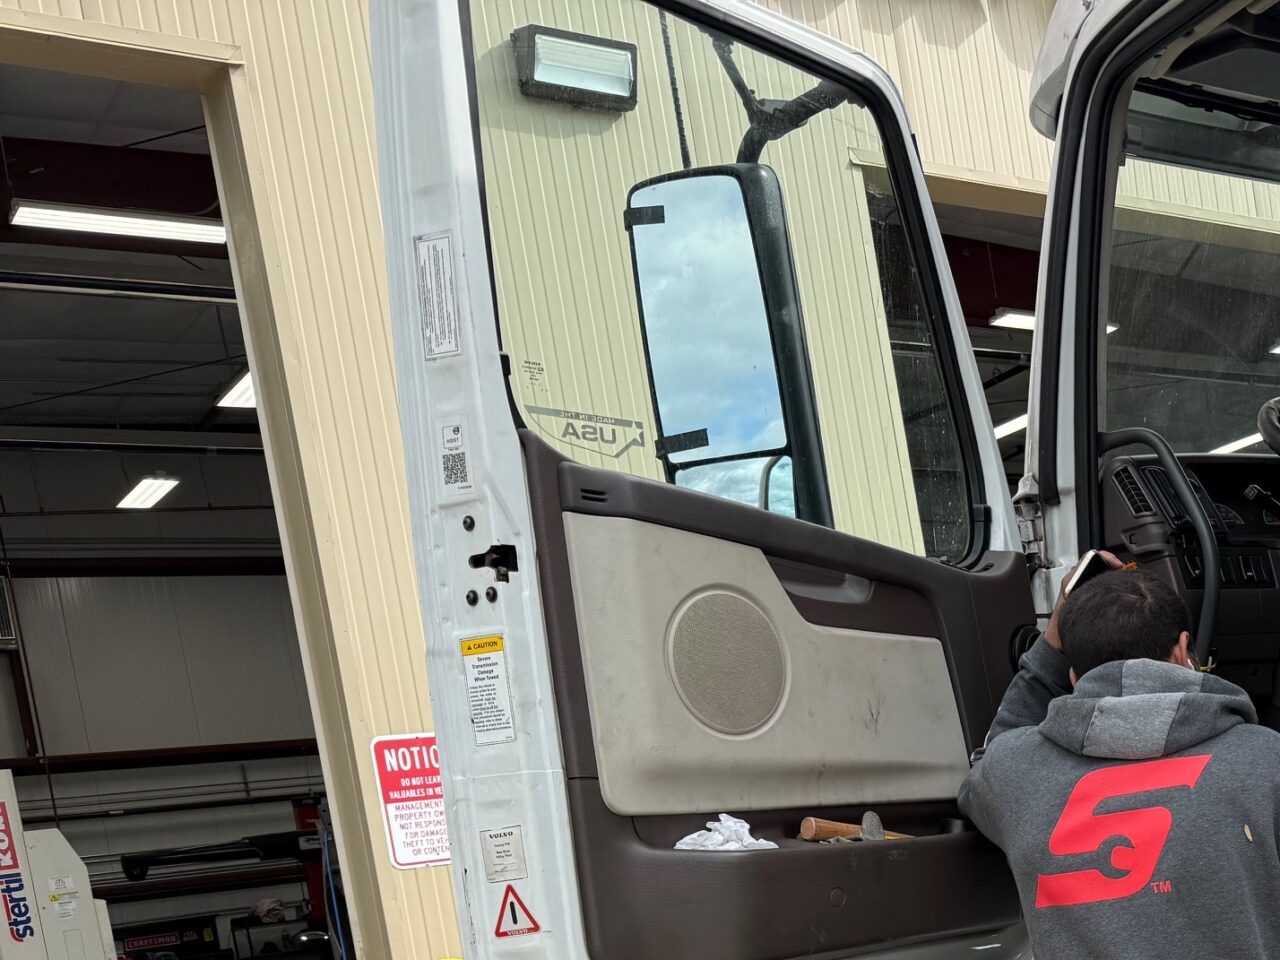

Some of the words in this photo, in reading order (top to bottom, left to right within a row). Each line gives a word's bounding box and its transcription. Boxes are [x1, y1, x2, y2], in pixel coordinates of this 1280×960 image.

[473, 640, 498, 650] CAUTION
[472, 661, 498, 670] Transmission
[400, 778, 410, 787] DO
[412, 776, 424, 786] NOT
[388, 788, 426, 799] VALUABLES
[426, 787, 434, 796] IN
[394, 811, 432, 822] PROPERTY
[399, 822, 413, 830] NOT
[488, 831, 514, 839] VOLVO
[403, 839, 425, 848] THEFT
[426, 838, 434, 846] TO
[412, 848, 422, 856] OR
[1151, 880, 1172, 894] TM
[0, 872, 34, 942] stertil
[507, 928, 529, 936] VOLVO
[127, 934, 177, 949] CRAFTSMAN
